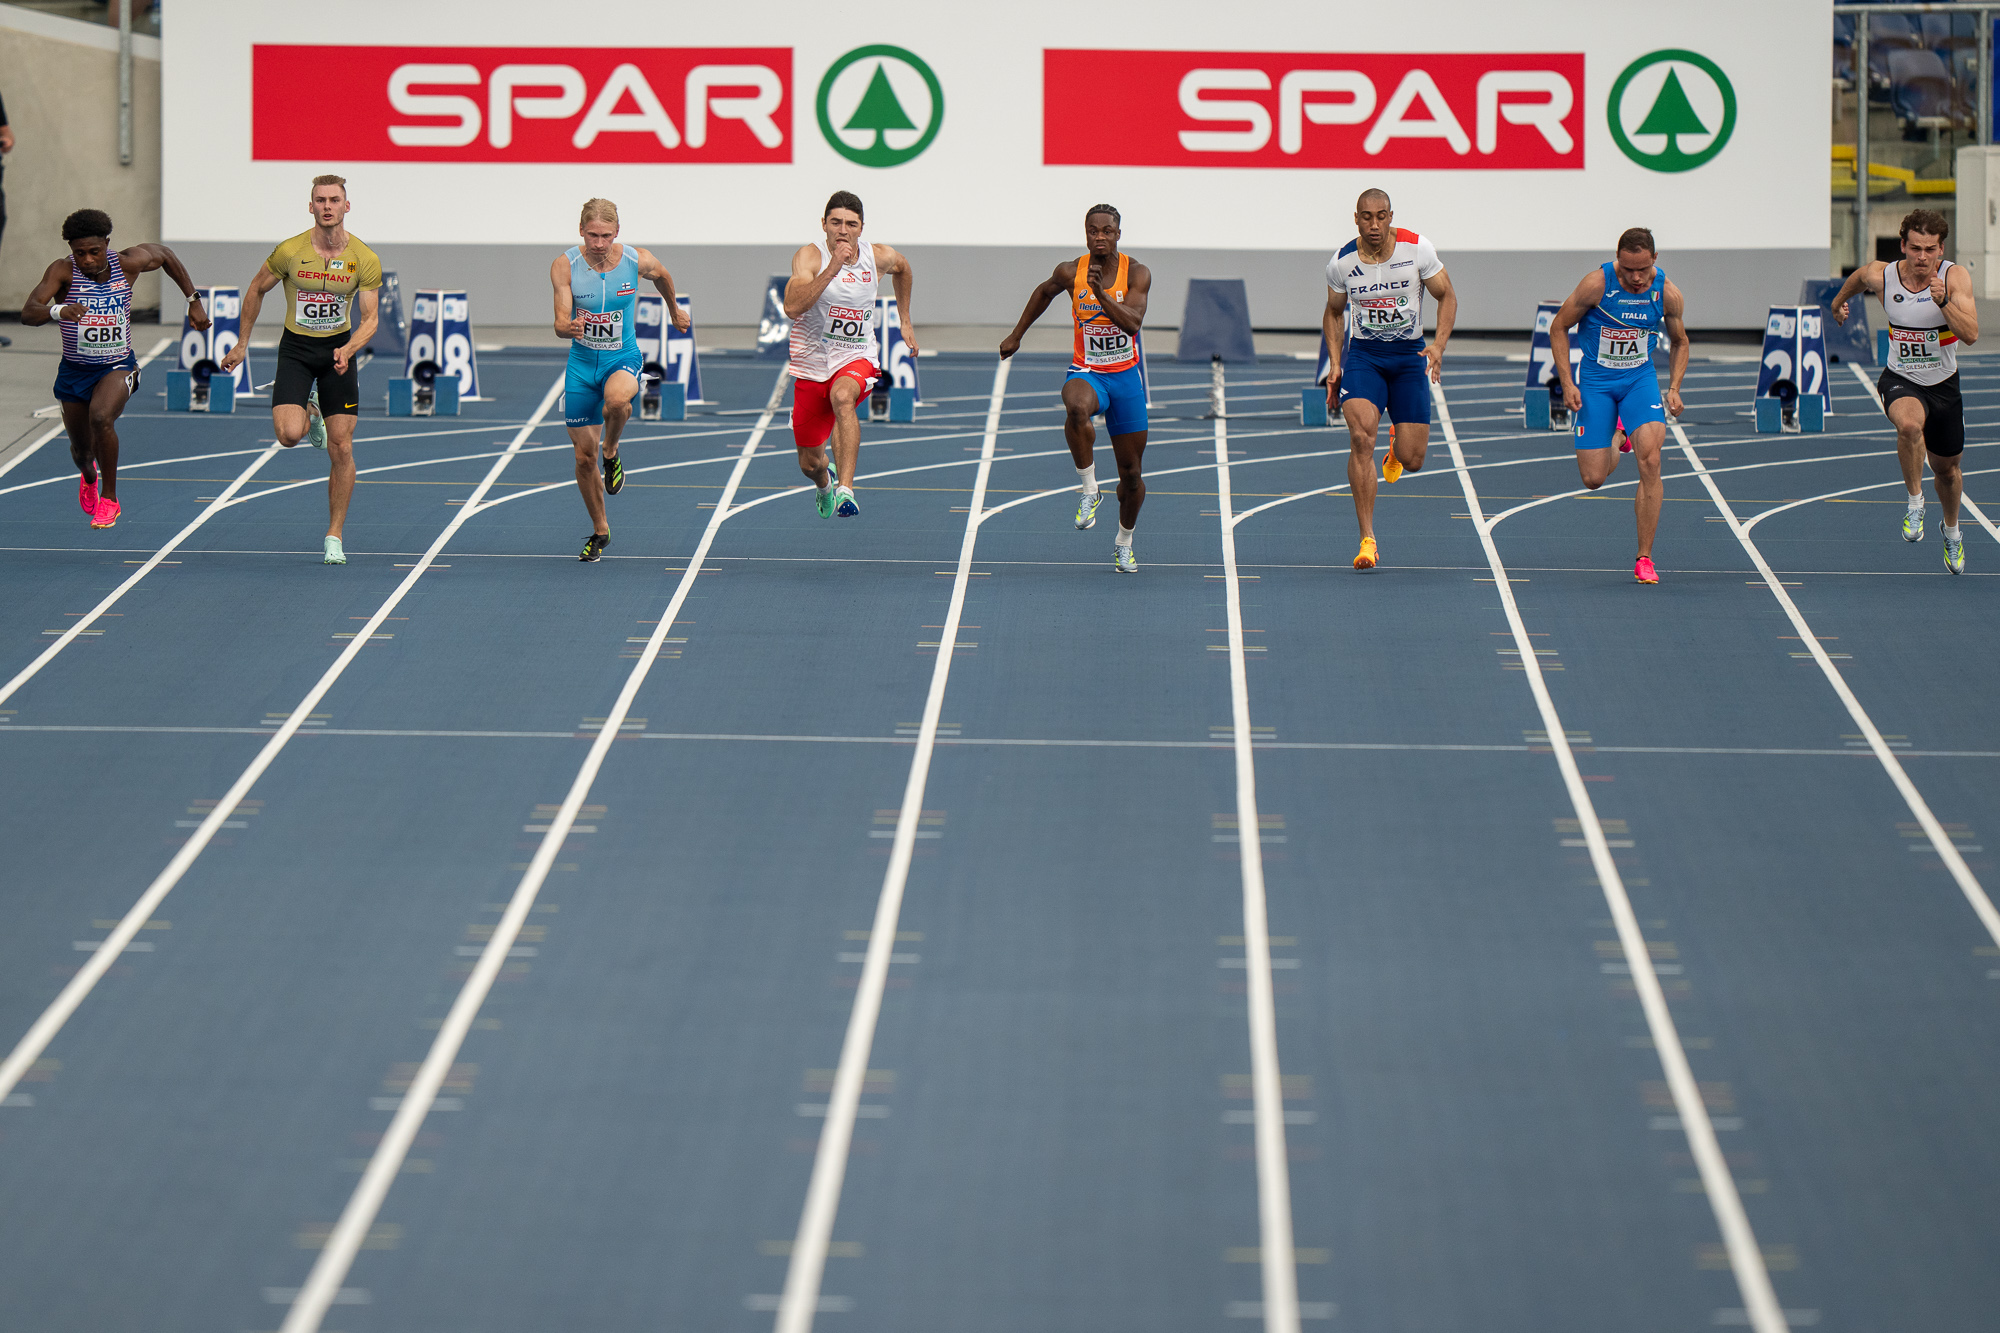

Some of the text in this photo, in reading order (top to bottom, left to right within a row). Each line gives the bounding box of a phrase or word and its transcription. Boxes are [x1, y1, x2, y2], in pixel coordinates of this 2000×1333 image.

[388, 64, 782, 148] SPAR
[1179, 69, 1573, 154] SPAR
[297, 270, 351, 283] GERMANY
[1351, 280, 1409, 295] FRANCE
[77, 295, 125, 308] GREAT
[298, 292, 335, 302] SPAR
[1361, 299, 1395, 307] SPAR
[86, 306, 125, 315] RITAIN
[304, 304, 340, 318] GER
[578, 310, 609, 322] SPAR
[830, 308, 862, 320] SPAR
[1368, 309, 1404, 323] FRA
[80, 316, 116, 325] SPAR
[830, 319, 864, 336] POL
[84, 327, 122, 342] GBR
[584, 322, 613, 337] FIN
[1086, 326, 1119, 335] SPAR
[1603, 329, 1637, 338] SPAR
[1893, 331, 1924, 341] SPAR
[1090, 335, 1127, 350] NED
[1610, 341, 1638, 355] ITA
[1900, 343, 1932, 357] BEL
[444, 333, 473, 395] 8
[668, 338, 693, 400] 7
[890, 340, 915, 389] 6
